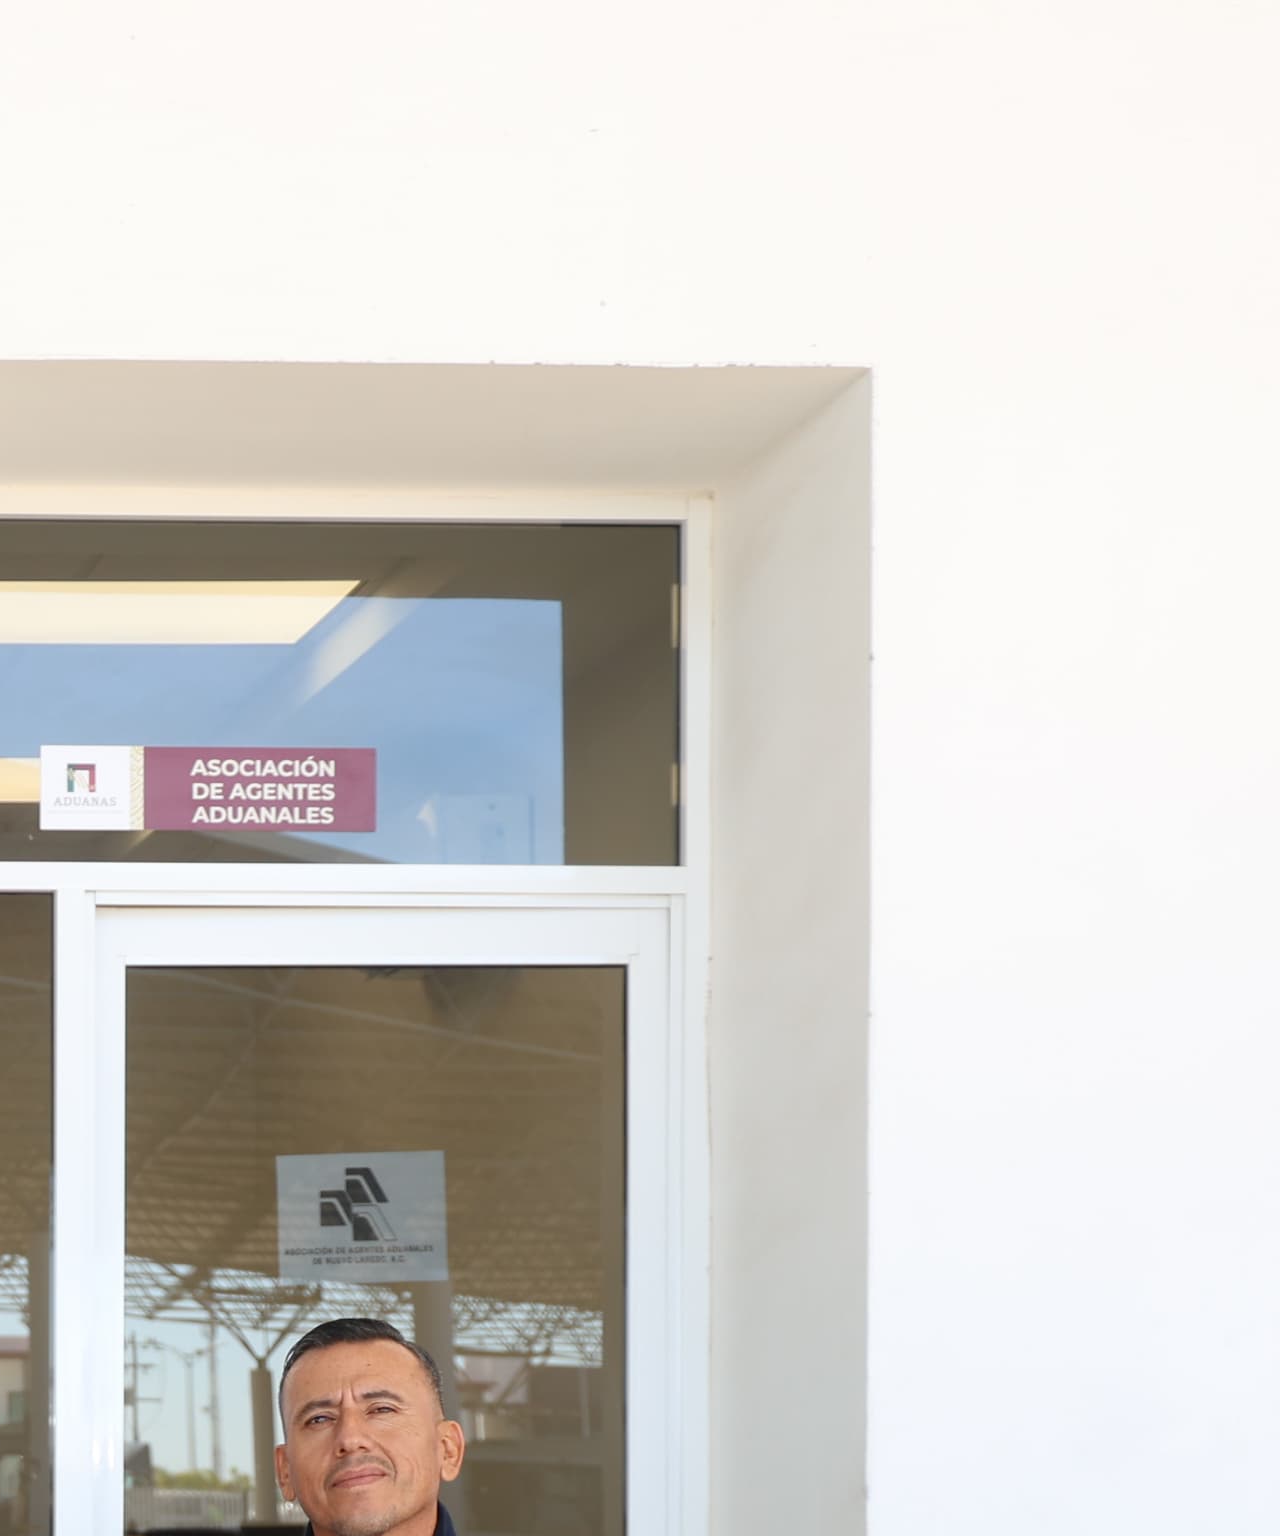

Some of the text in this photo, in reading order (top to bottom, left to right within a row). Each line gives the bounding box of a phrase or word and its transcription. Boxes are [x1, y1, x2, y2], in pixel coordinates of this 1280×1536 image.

[190, 755, 336, 778] ASOCIACIÓN
[192, 782, 336, 801] DE AGENTES
[53, 796, 117, 807] ADUANAS
[191, 805, 335, 825] ADUANALES
